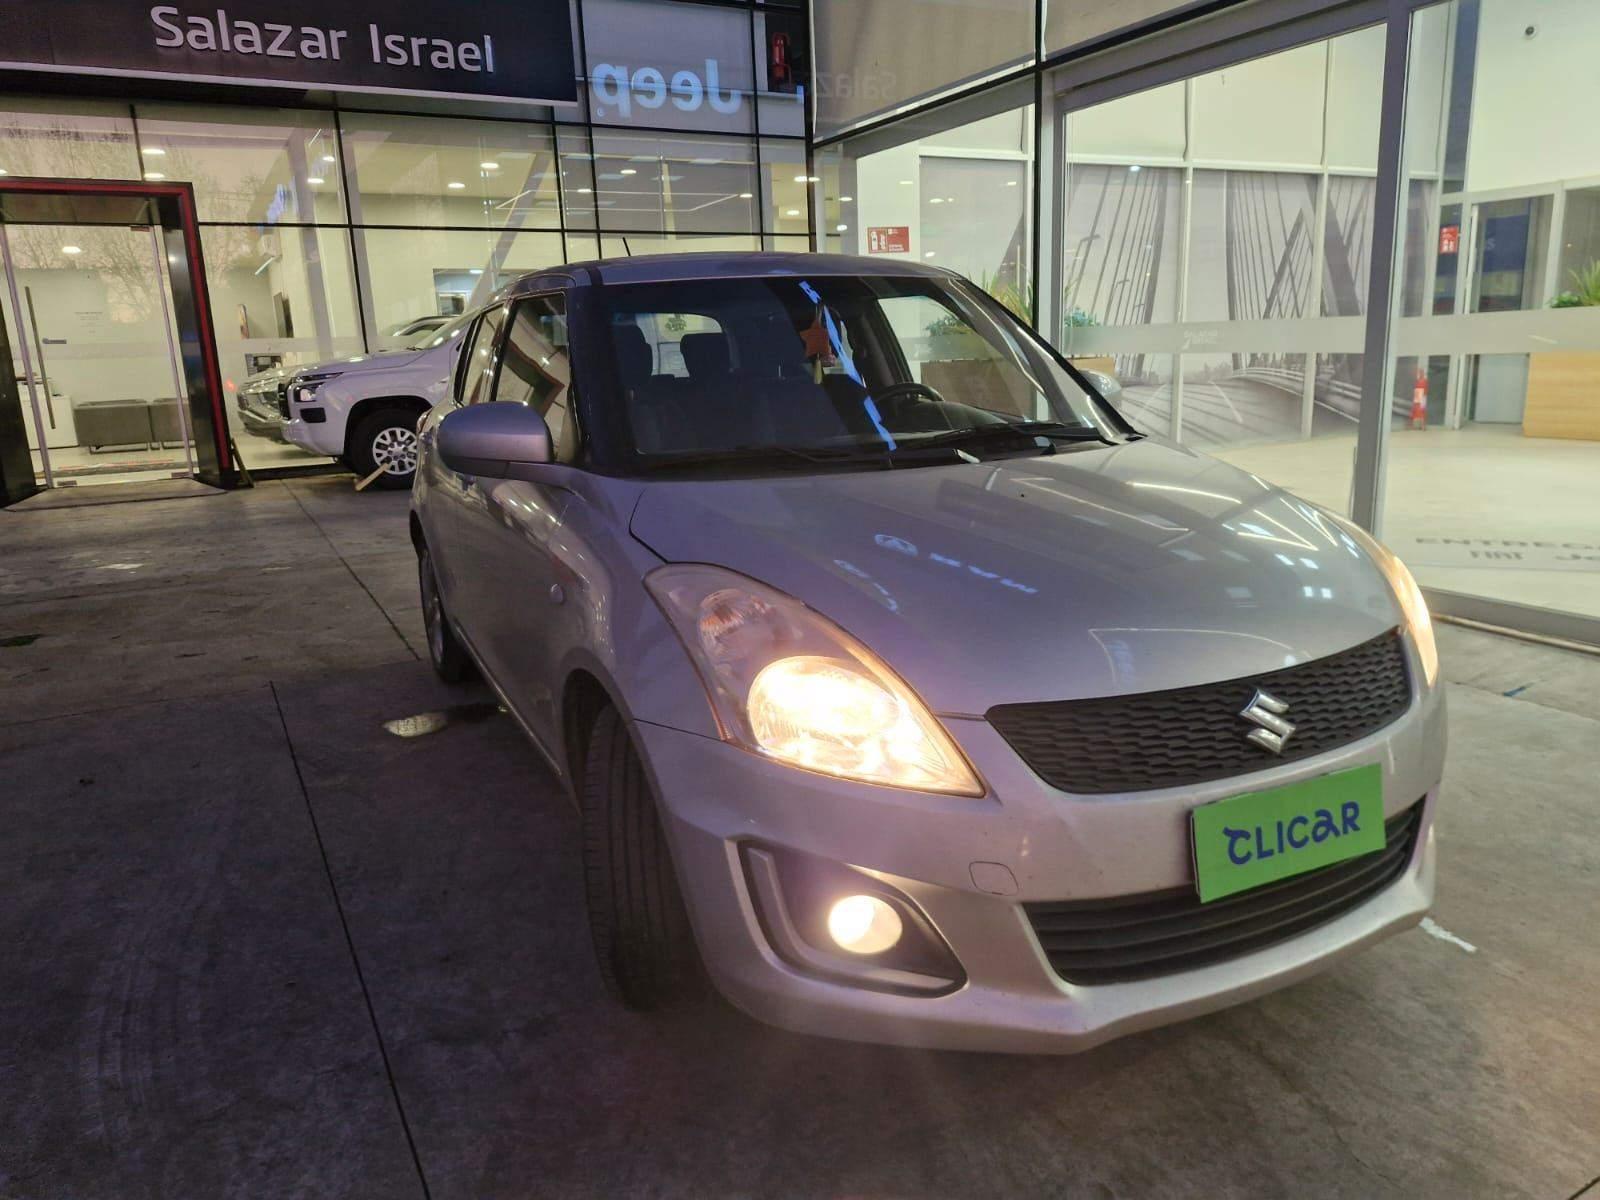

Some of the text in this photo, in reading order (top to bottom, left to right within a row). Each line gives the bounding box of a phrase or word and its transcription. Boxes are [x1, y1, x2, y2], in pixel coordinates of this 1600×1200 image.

[150, 5, 495, 73] Salazar Israel
[1415, 538, 1600, 550] ENTREG
